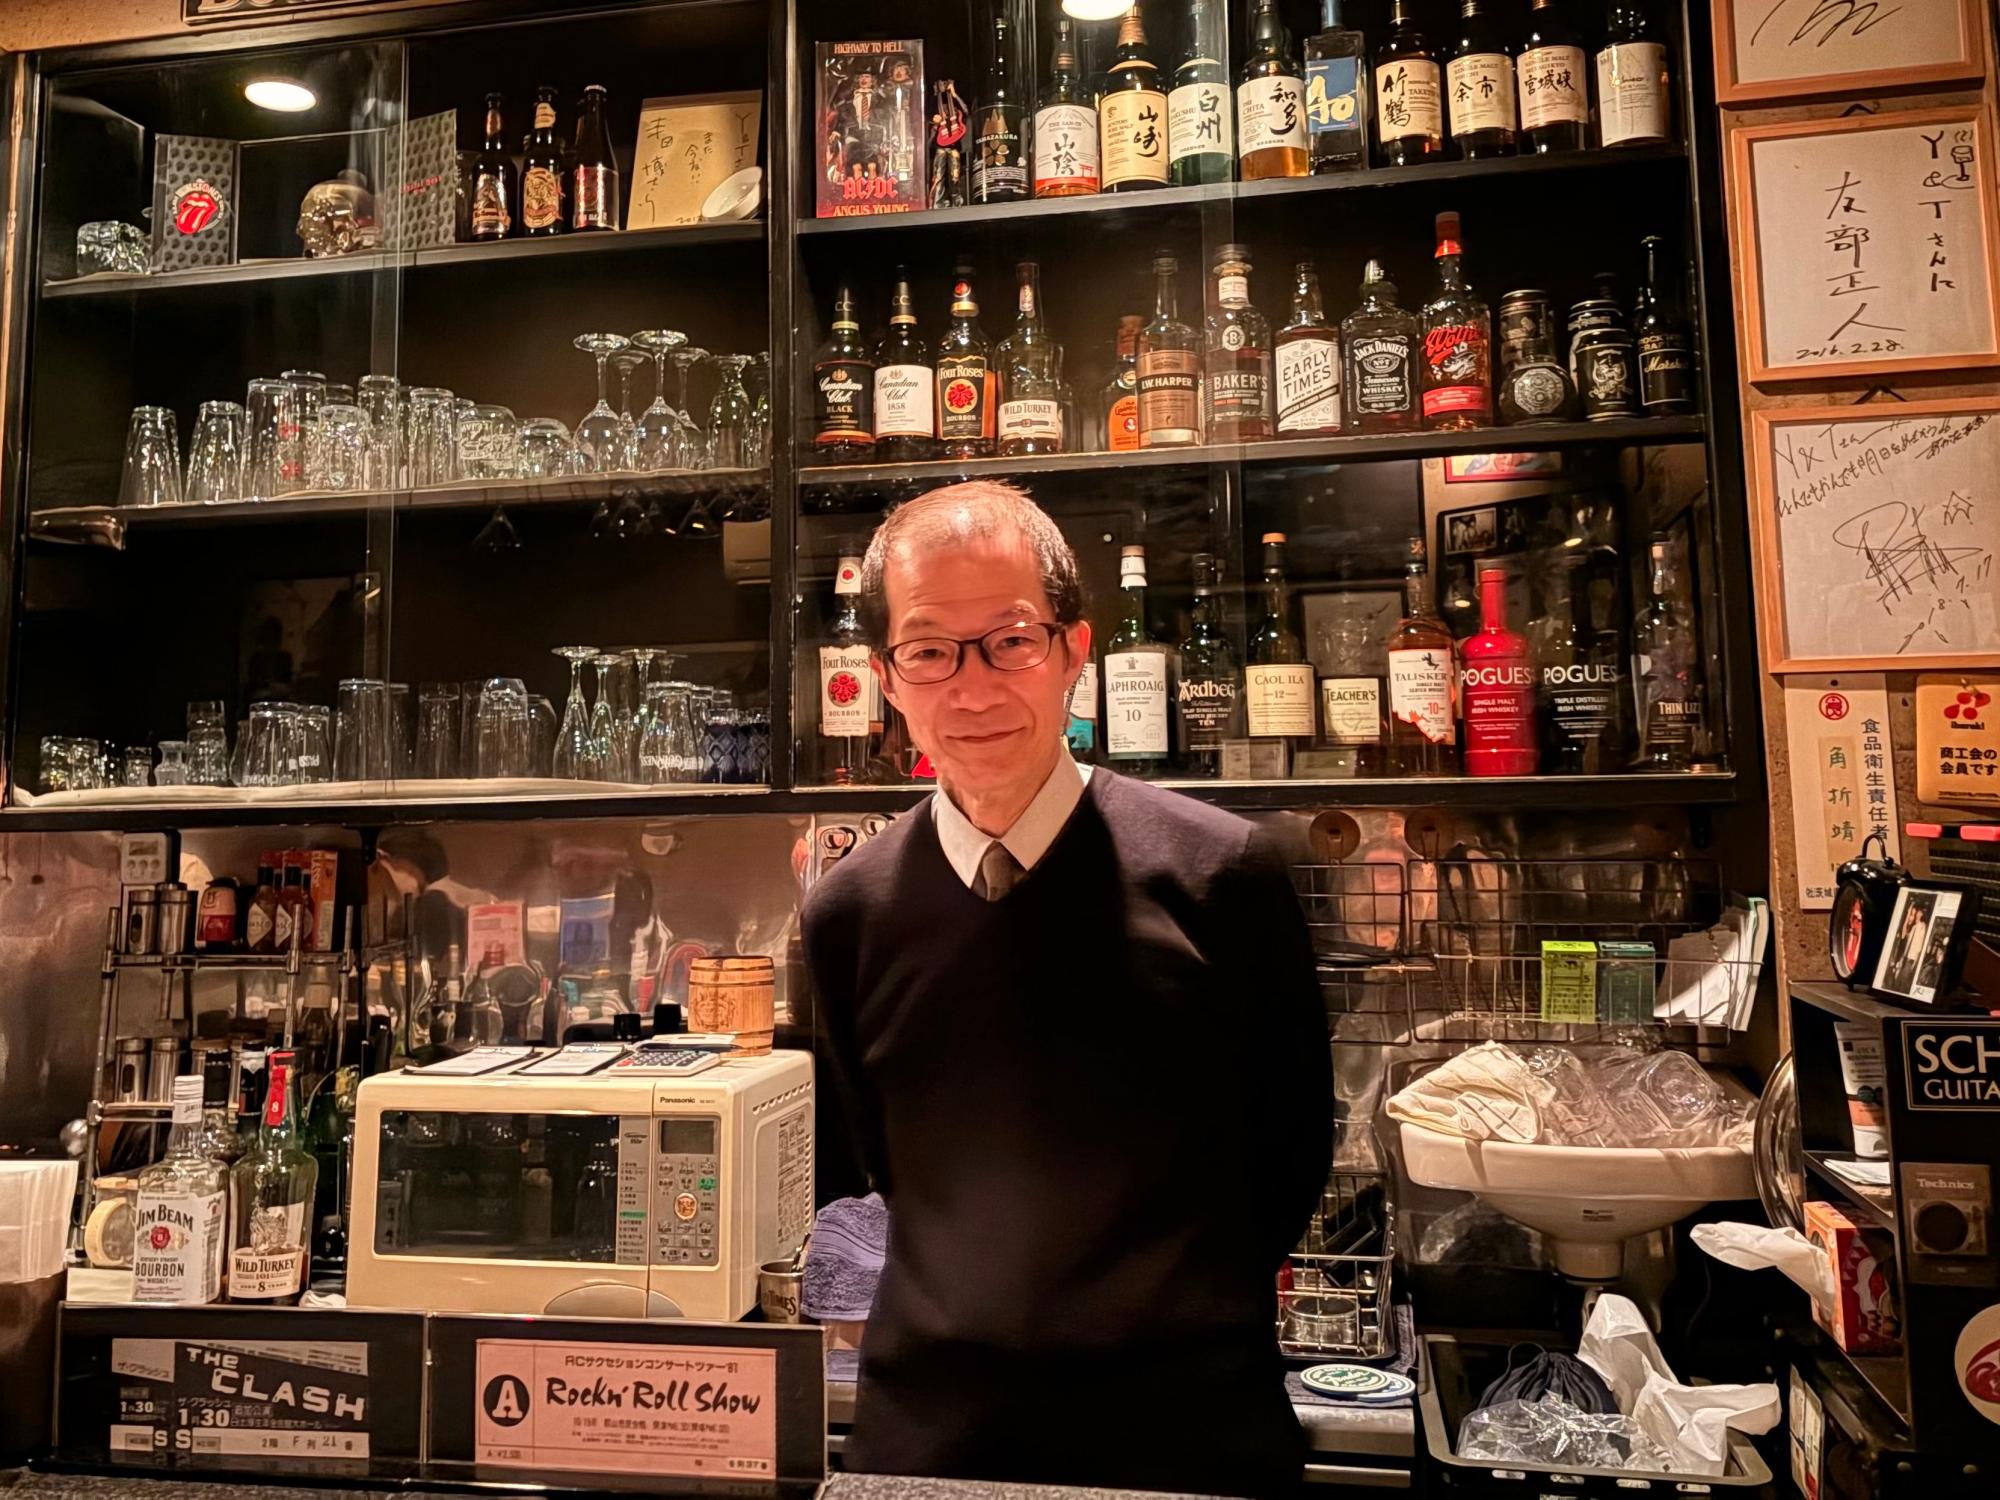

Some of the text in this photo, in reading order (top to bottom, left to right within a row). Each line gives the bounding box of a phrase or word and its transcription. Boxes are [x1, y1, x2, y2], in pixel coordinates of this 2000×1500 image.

[834, 42, 904, 55] HIGHWAY TO HELL
[1453, 76, 1497, 102] 余市
[1524, 69, 1576, 96] 宮城峡
[1196, 89, 1221, 143] 白州
[1243, 103, 1265, 115] CHITA
[1134, 105, 1162, 157] 山崎
[1053, 133, 1077, 176] 山陰
[833, 203, 909, 216] ANGUS YOUNG
[1353, 341, 1410, 361] JACK DANIEL'S
[940, 365, 984, 379] Four Roses
[1283, 348, 1330, 382] EARLY
[819, 376, 863, 391] Canadian
[879, 377, 918, 390] Canadian
[1155, 377, 1192, 387] HARPER
[1214, 375, 1268, 390] BAKER'S
[1283, 365, 1332, 398] TIMES
[826, 389, 853, 403] Club
[885, 389, 909, 400] Club
[1362, 386, 1403, 394] WHISKEY
[826, 405, 853, 413] BLACK
[887, 403, 906, 411] 1858
[1004, 403, 1052, 415] WILD TURKEY
[823, 656, 869, 669] Four Roses
[1255, 675, 1305, 685] CAOL ILA
[1395, 673, 1448, 682] TALISKER
[1461, 667, 1531, 688] POGUES
[1543, 665, 1617, 685] POGUES
[1274, 690, 1285, 698] 12
[1324, 688, 1377, 704] TEACHER'S
[1125, 709, 1141, 721] 10
[1428, 703, 1439, 715] 10
[1658, 702, 1683, 714] THIN
[1940, 747, 1997, 760] 商工会の
[1940, 762, 1998, 775] 会員です
[1861, 718, 1890, 841] 食品衛生責任者
[272, 1101, 279, 1113] 8
[1916, 1178, 1975, 1190] Technics
[137, 1204, 193, 1232] JIM BEAM
[135, 1262, 184, 1277] BOURBON
[235, 1257, 296, 1272] WILD TURKEY
[257, 1281, 266, 1292] 8
[186, 1347, 239, 1369] THE
[211, 1368, 366, 1421] CLASH
[492, 1380, 523, 1418] A
[633, 1380, 689, 1411] Roll
[694, 1382, 760, 1414] Show
[155, 1430, 168, 1446] S
[175, 1429, 191, 1448] S
